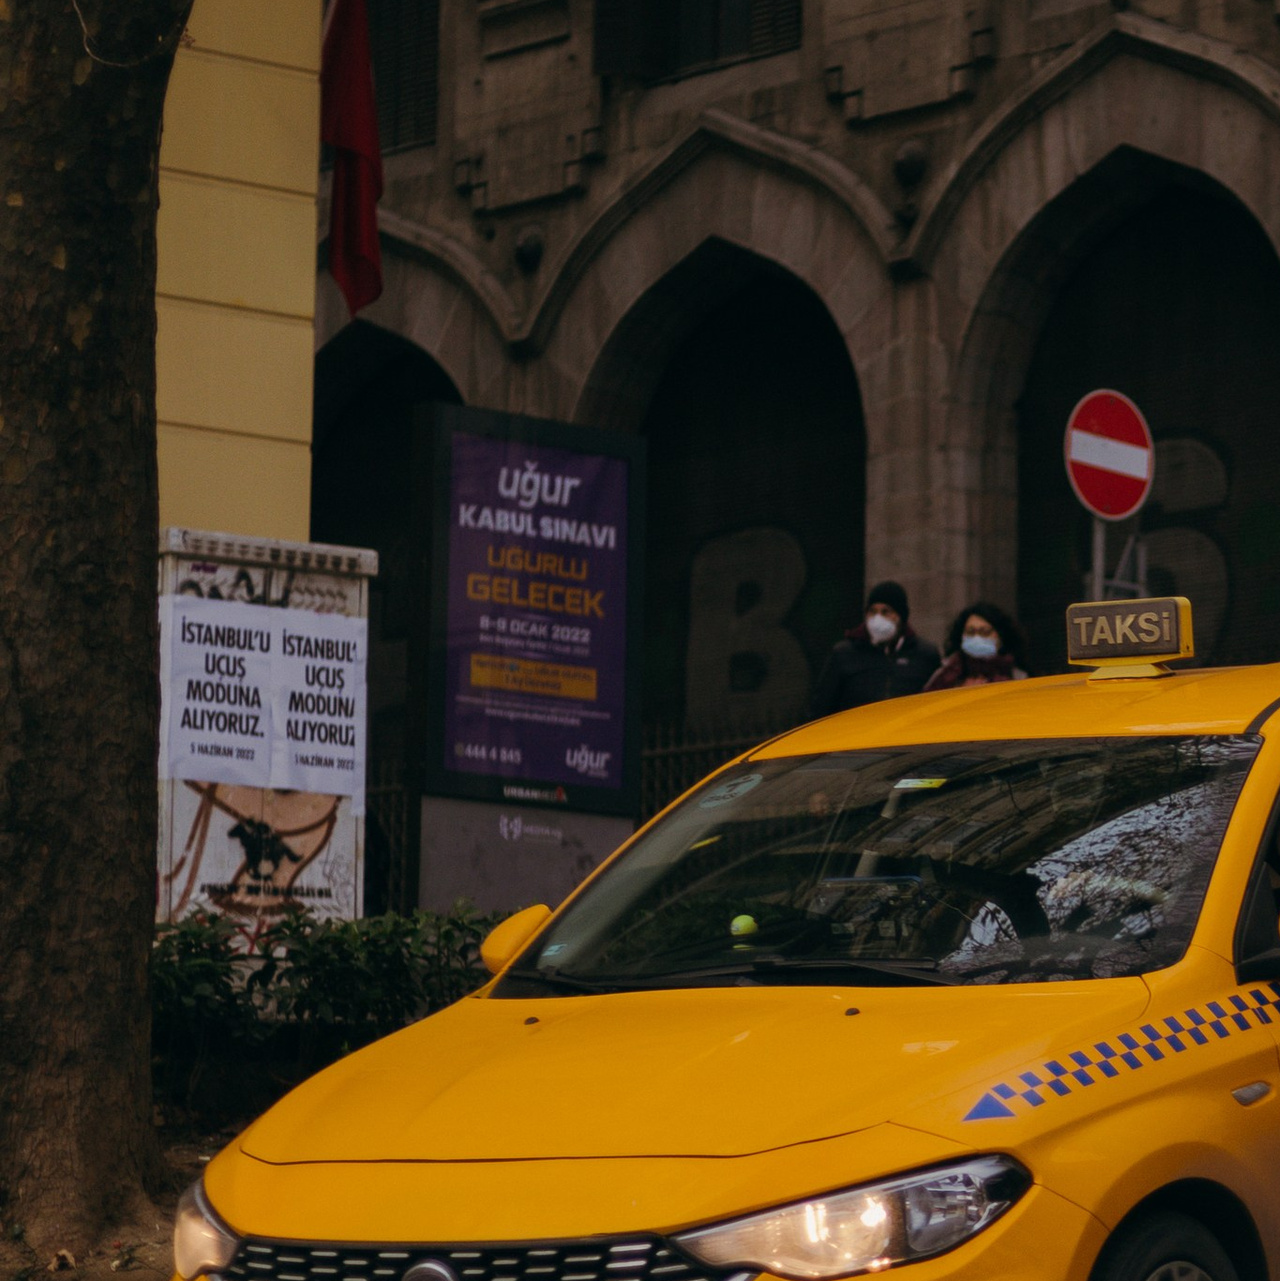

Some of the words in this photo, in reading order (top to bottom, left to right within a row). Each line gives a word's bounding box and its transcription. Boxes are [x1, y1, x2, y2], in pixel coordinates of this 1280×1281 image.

[497, 460, 582, 509] uğur
[458, 503, 537, 538] KABUL
[539, 516, 618, 550] SINAVI
[487, 543, 590, 582] UĞURLU
[466, 572, 606, 618] GELECEK
[181, 616, 271, 653] İSTANBUL'U
[510, 619, 548, 639] OCAK
[551, 624, 592, 643] 2022
[205, 653, 246, 680] UÇUŞ
[305, 665, 345, 692] UÇUŞ
[186, 680, 262, 709] MODUNA
[181, 708, 264, 738] ALIYORUZ.
[565, 743, 612, 773] uğur
